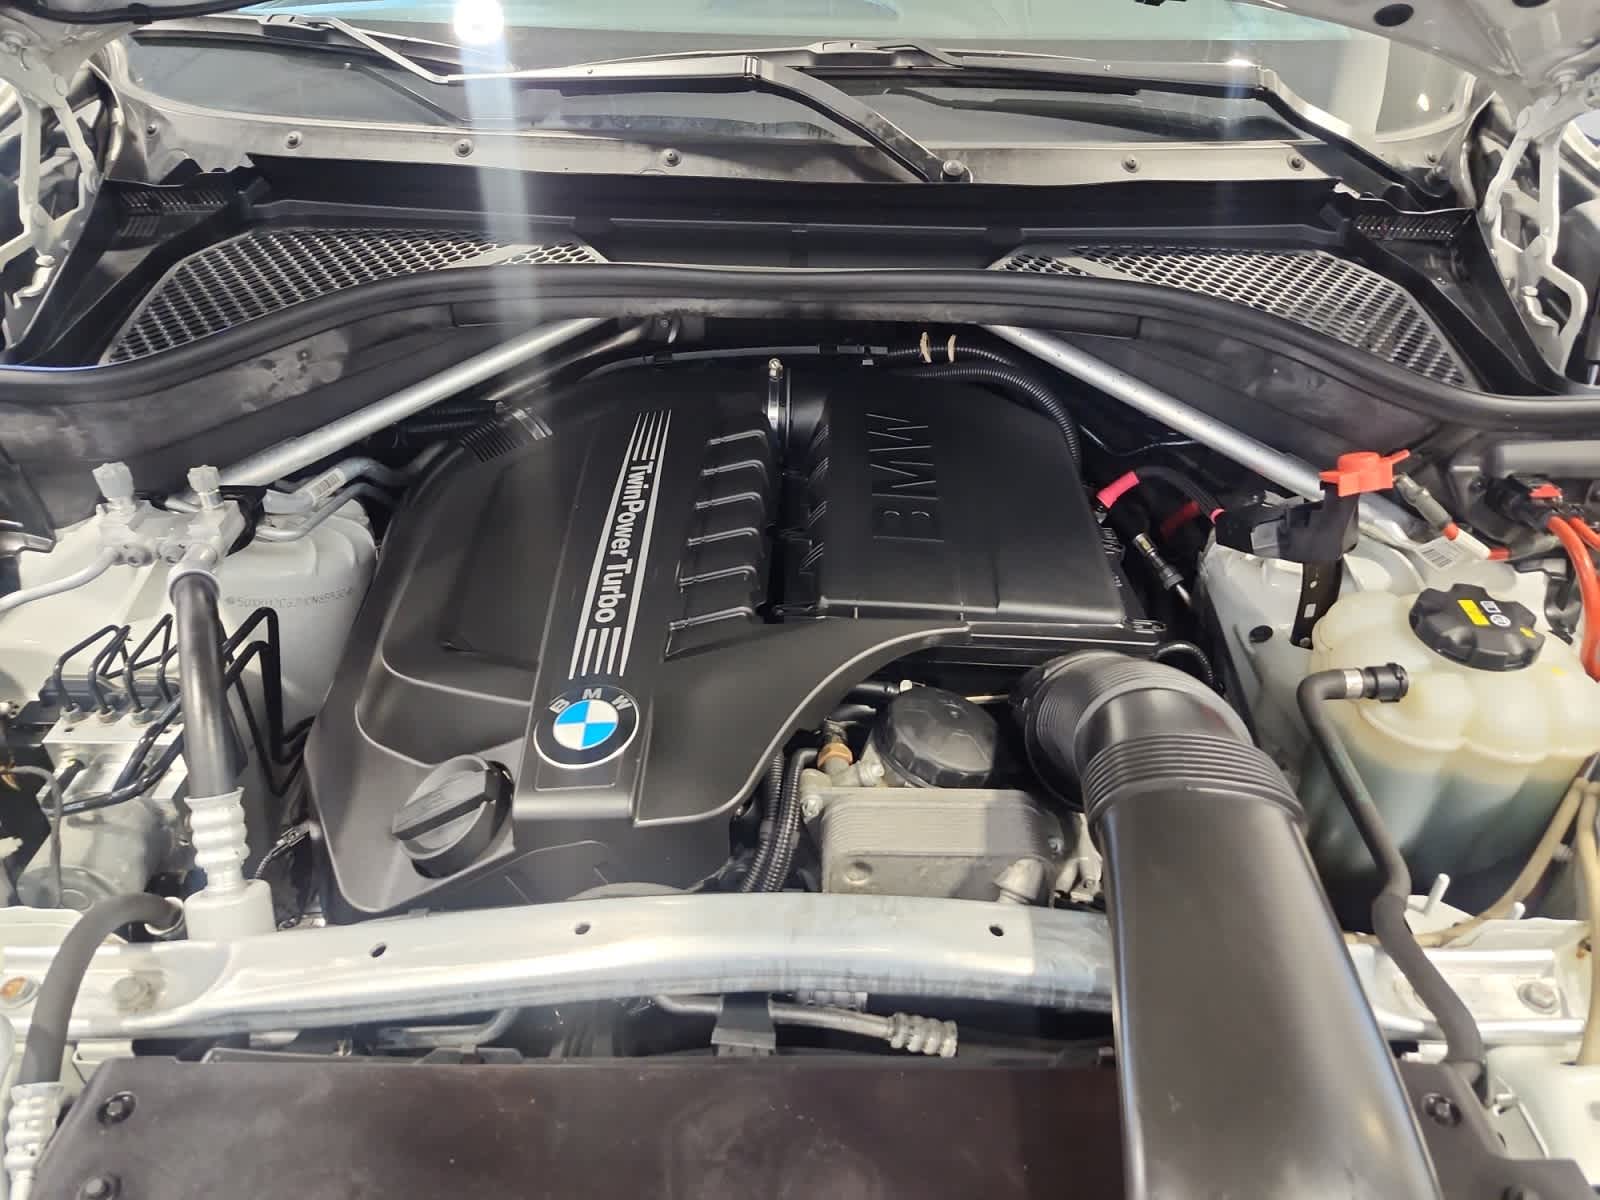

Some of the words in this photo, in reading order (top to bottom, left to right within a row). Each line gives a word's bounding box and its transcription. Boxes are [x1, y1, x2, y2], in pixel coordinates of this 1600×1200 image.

[608, 461, 654, 557] TwinPower
[864, 412, 945, 543] BMW
[594, 558, 633, 624] Turbo
[549, 688, 632, 714] BMW
